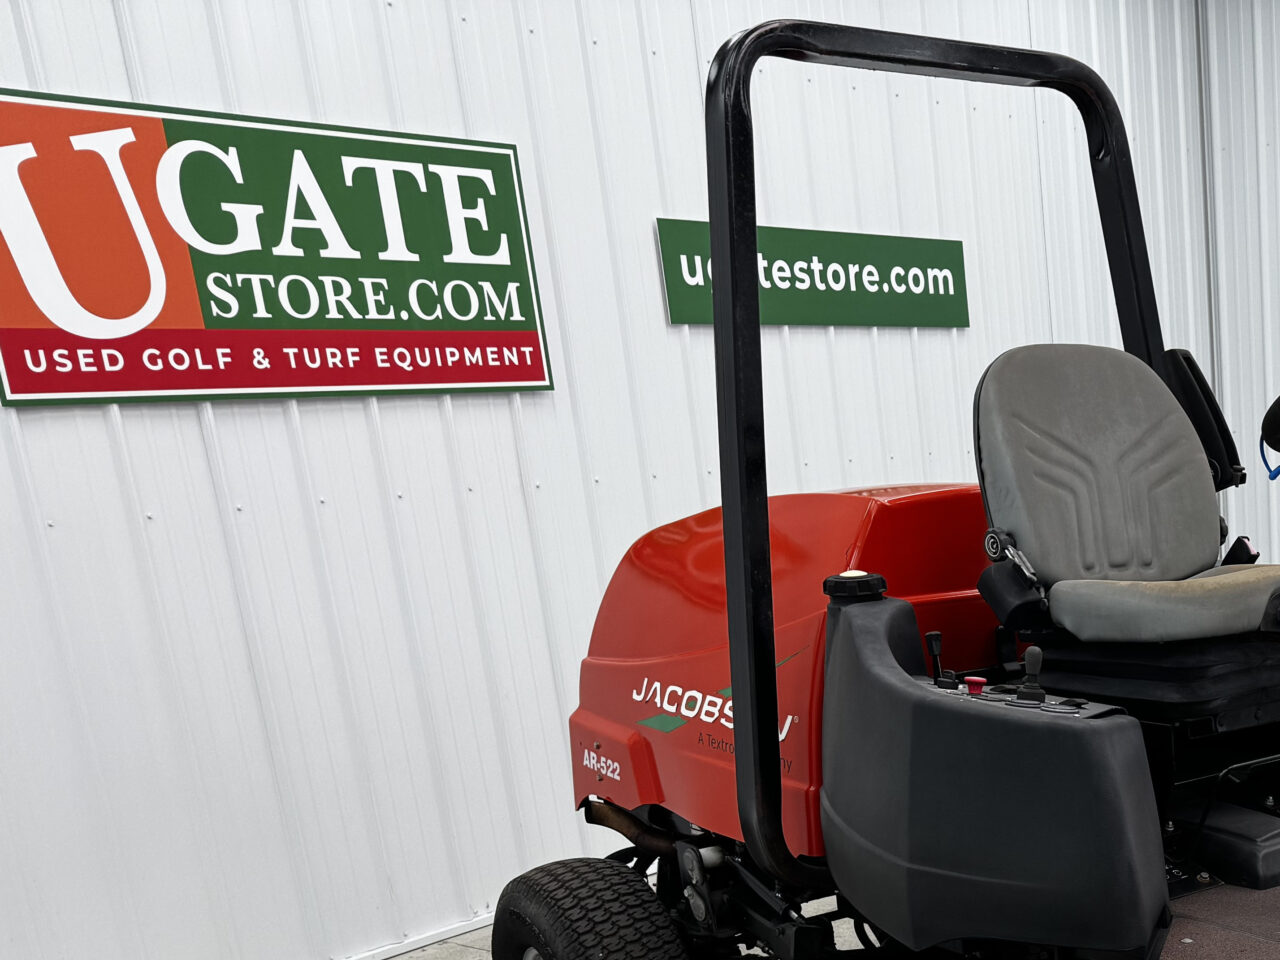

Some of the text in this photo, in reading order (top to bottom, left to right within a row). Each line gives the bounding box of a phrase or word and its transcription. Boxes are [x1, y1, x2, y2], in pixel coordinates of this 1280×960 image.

[680, 253, 955, 296] utestore.com
[205, 271, 526, 321] STORE.COM
[23, 346, 534, 373] USED GOLF & TURF EQUIPMENT
[632, 677, 793, 742] JACOBS
[706, 733, 735, 754] Textro
[583, 748, 621, 781] AR-522
